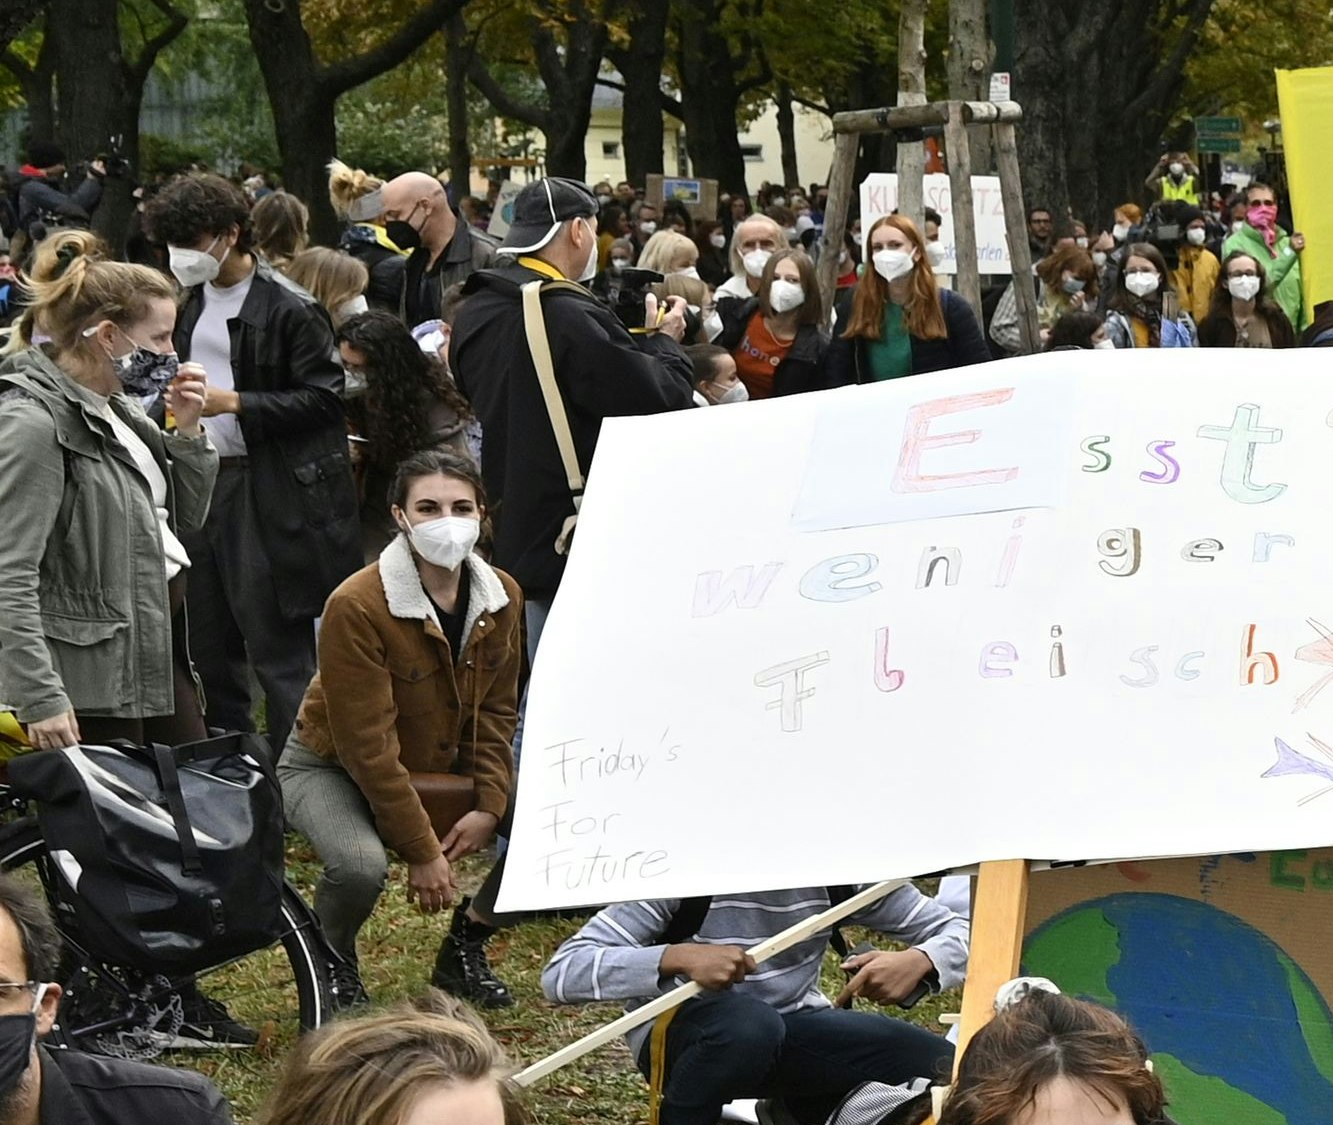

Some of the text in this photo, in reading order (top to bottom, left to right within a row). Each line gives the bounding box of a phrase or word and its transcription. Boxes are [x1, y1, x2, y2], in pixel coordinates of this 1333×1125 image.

[691, 515, 1296, 621] weniger
[543, 727, 684, 788] Friday's
[538, 799, 623, 845] For
[536, 845, 673, 892] Future
